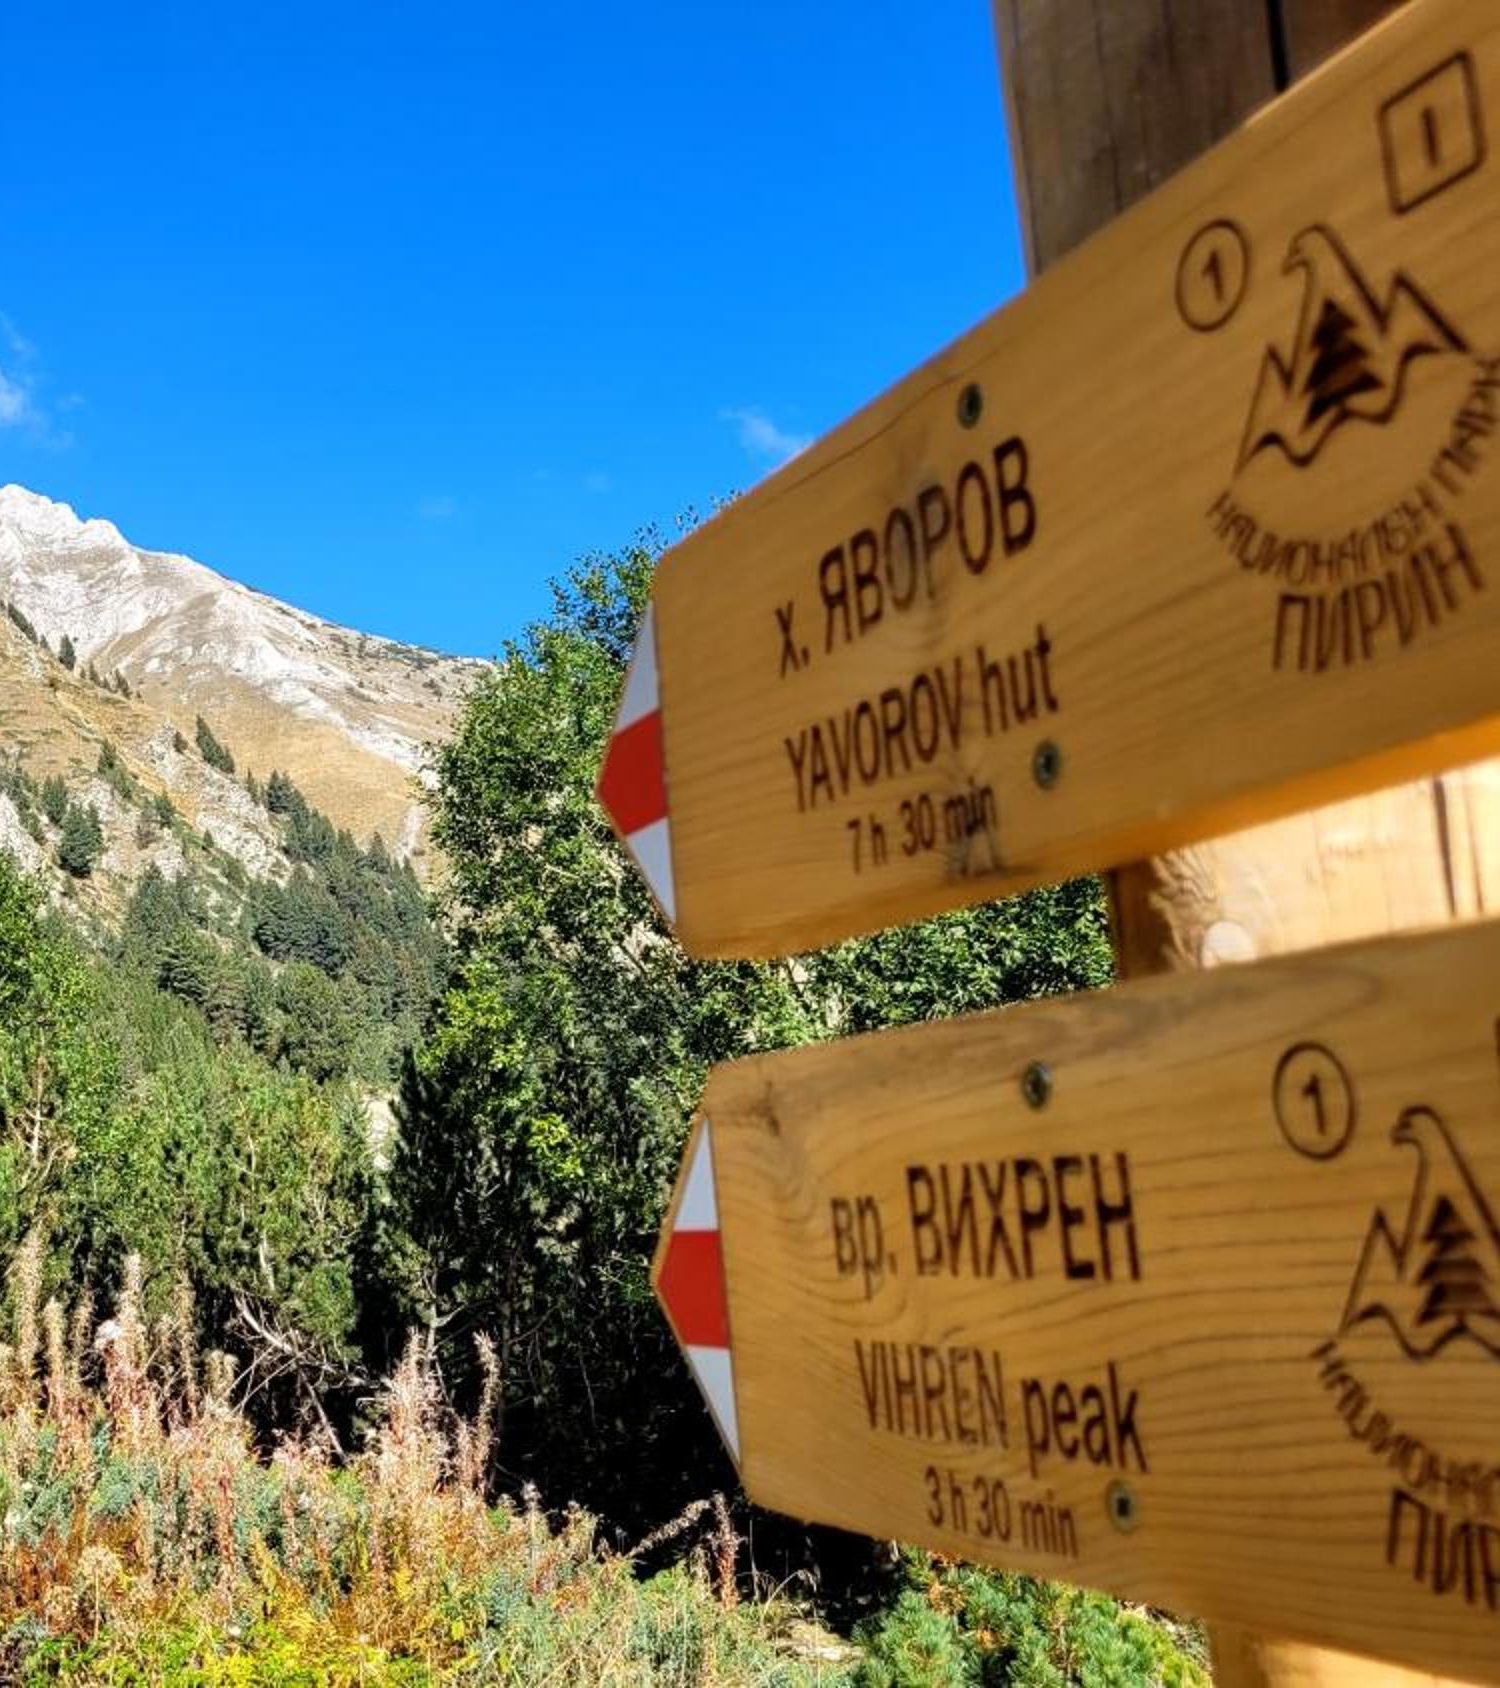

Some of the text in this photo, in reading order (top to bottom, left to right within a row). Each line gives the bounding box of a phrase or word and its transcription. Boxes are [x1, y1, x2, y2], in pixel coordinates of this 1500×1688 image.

[1203, 250, 1224, 301] 1
[818, 434, 1037, 656] ЯВОРОВ
[1271, 521, 1485, 675] ПИРИН
[784, 622, 1059, 815] YAVOROV hut
[900, 792, 936, 858] 30
[943, 776, 998, 845] min
[1303, 1073, 1327, 1137] 1
[905, 1151, 1142, 1282] ВИХРЕН
[854, 1338, 1149, 1480] VIHREN peak
[973, 1474, 1012, 1542] 30
[1018, 1487, 1079, 1557] min
